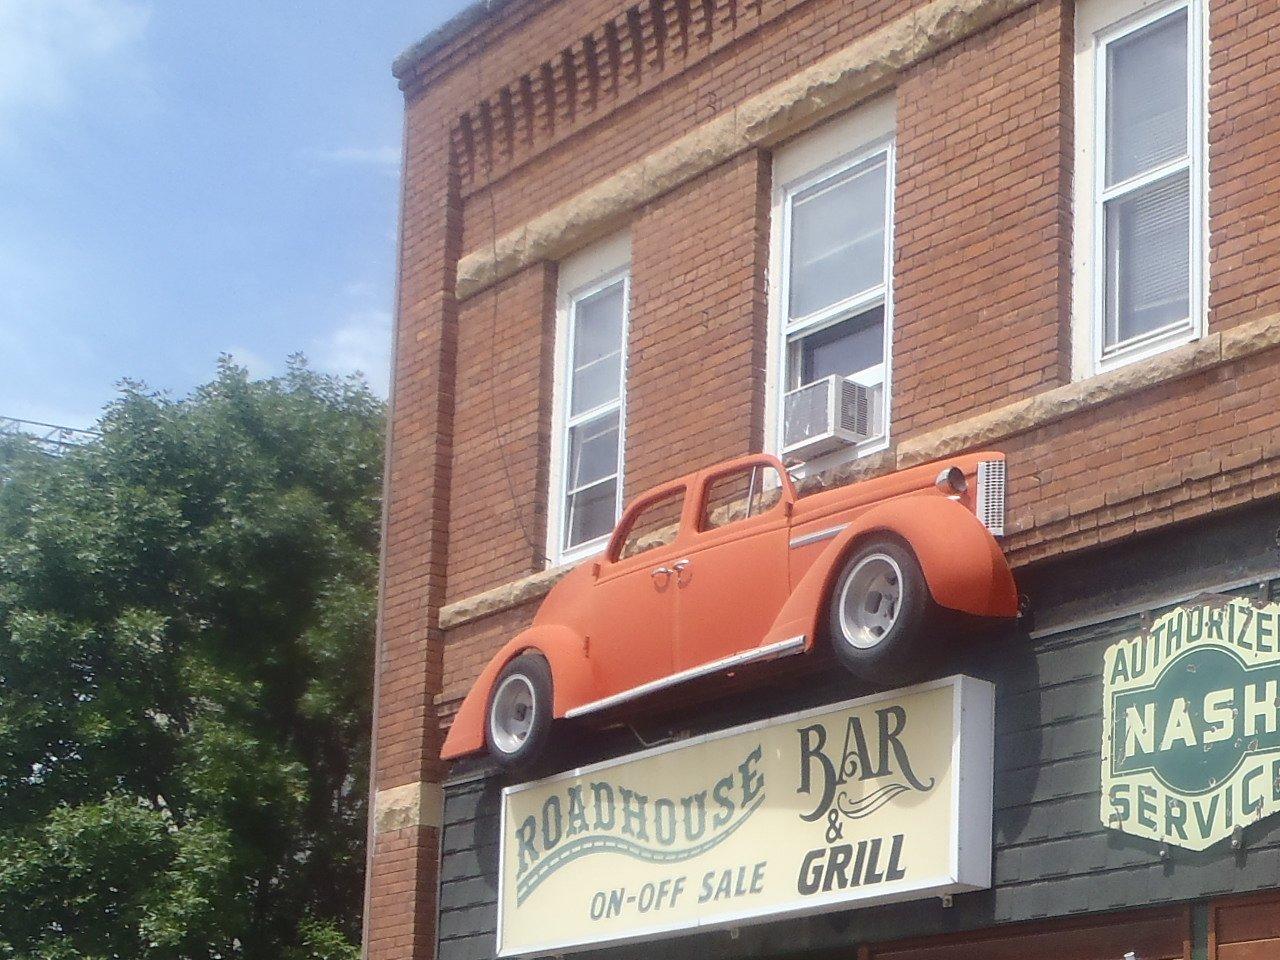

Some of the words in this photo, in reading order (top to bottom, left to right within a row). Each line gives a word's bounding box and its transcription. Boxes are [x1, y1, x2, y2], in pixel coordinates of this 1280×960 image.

[1125, 679, 1278, 758] NASH
[796, 704, 935, 823] BAR
[516, 743, 765, 875] ROADHOUSE
[826, 808, 843, 843] &
[590, 875, 686, 922] ON-OFF
[697, 860, 767, 904] SALE
[797, 833, 906, 896] GRILL
